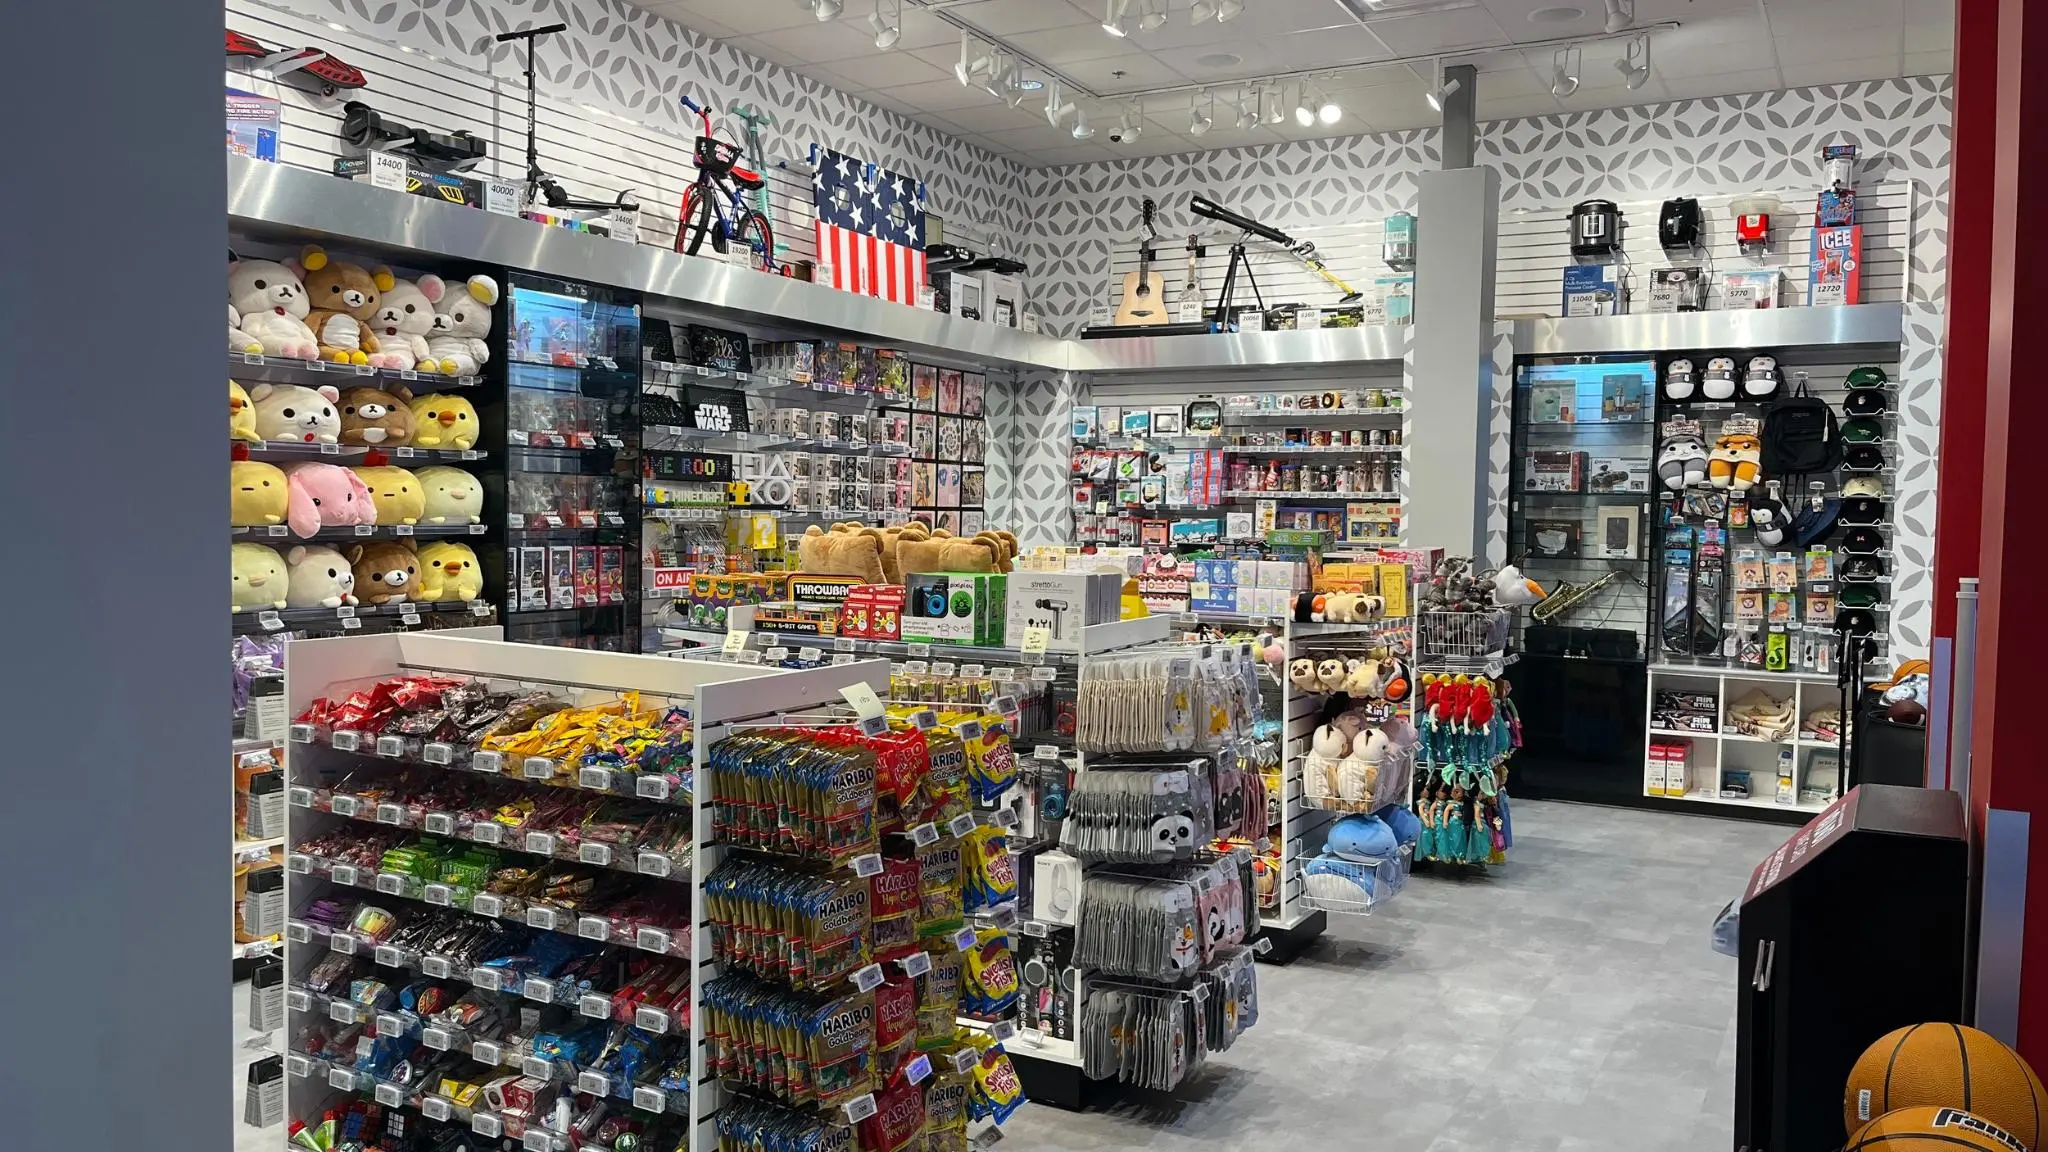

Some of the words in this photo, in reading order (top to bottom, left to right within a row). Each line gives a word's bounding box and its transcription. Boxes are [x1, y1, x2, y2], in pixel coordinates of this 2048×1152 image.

[377, 157, 402, 170] 14400
[490, 185, 515, 196] 40000
[615, 214, 633, 225] 14400
[1819, 229, 1852, 250] ICEE
[1817, 285, 1841, 293] 12720
[715, 358, 736, 370] RULE
[695, 403, 729, 419] STAR
[695, 414, 732, 432] WARS
[672, 490, 726, 503] MINECRAFT
[656, 574, 673, 585] ON
[795, 584, 849, 596] THROWBA
[1695, 696, 1713, 704] AIR
[993, 755, 1015, 774] Fish
[832, 767, 875, 792] HARIBO
[836, 786, 874, 804] Goldbears
[920, 848, 959, 868] HARIBO
[875, 871, 917, 894] HARIBO
[996, 865, 1014, 885] Fish
[818, 891, 866, 919] HARIBO
[823, 910, 864, 932] Goldbears
[929, 965, 961, 983] HARIBO
[991, 970, 1014, 993] Fish
[821, 1005, 872, 1038] HARIBO
[827, 1027, 871, 1049] Goldbears
[928, 1084, 965, 1106] HARIBO
[996, 1076, 1018, 1096] Fish
[879, 1092, 922, 1131] HARIBO
[809, 1126, 853, 1152] HARIBO
